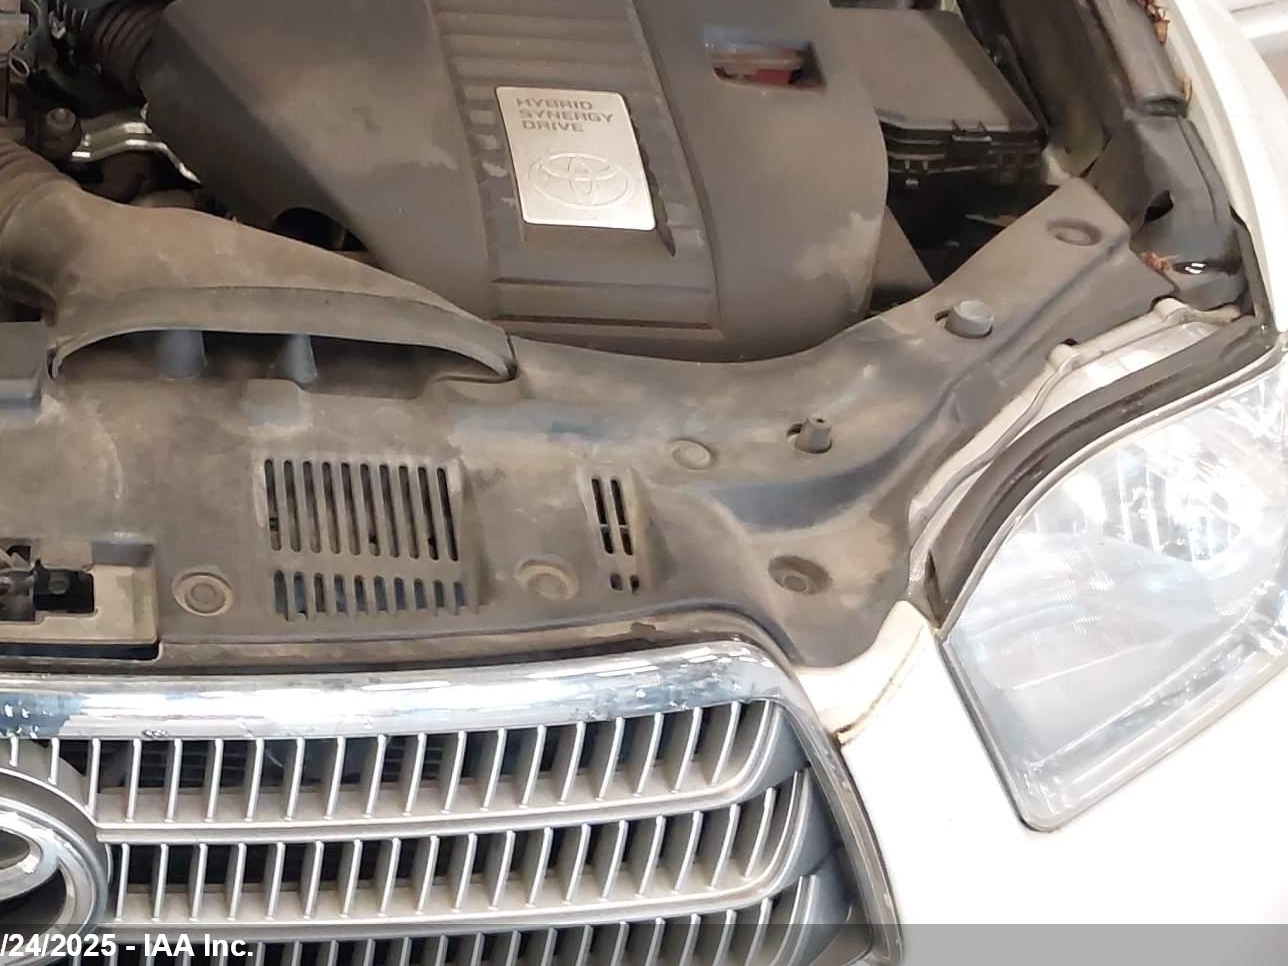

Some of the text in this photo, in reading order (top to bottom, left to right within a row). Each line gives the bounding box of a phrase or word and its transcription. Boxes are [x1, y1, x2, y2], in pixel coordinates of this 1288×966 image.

[515, 97, 593, 111] HYBRID
[518, 109, 614, 123] SYNERGY
[522, 120, 585, 133] DRIVE
